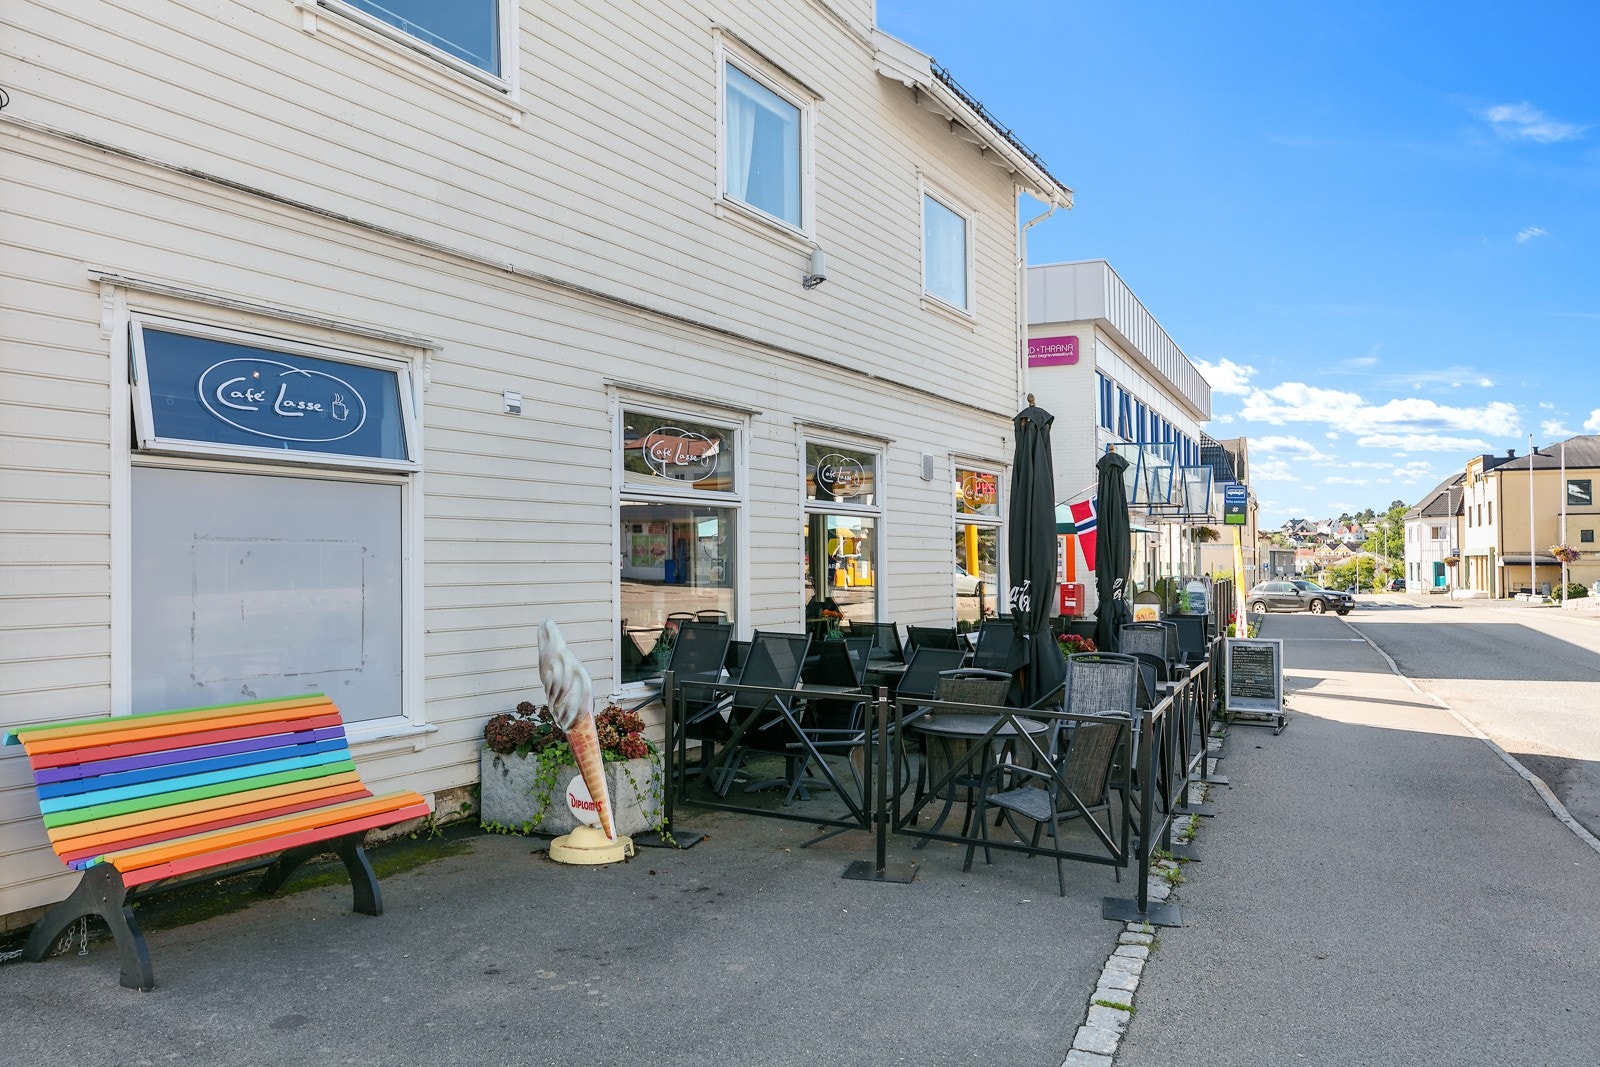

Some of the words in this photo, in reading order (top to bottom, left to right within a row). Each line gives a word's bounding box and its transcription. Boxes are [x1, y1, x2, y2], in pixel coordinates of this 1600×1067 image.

[1040, 343, 1074, 353] THRANA
[216, 376, 265, 411] Café
[274, 382, 324, 417] Lasse
[650, 439, 673, 464] Café
[675, 442, 699, 466] Lasse
